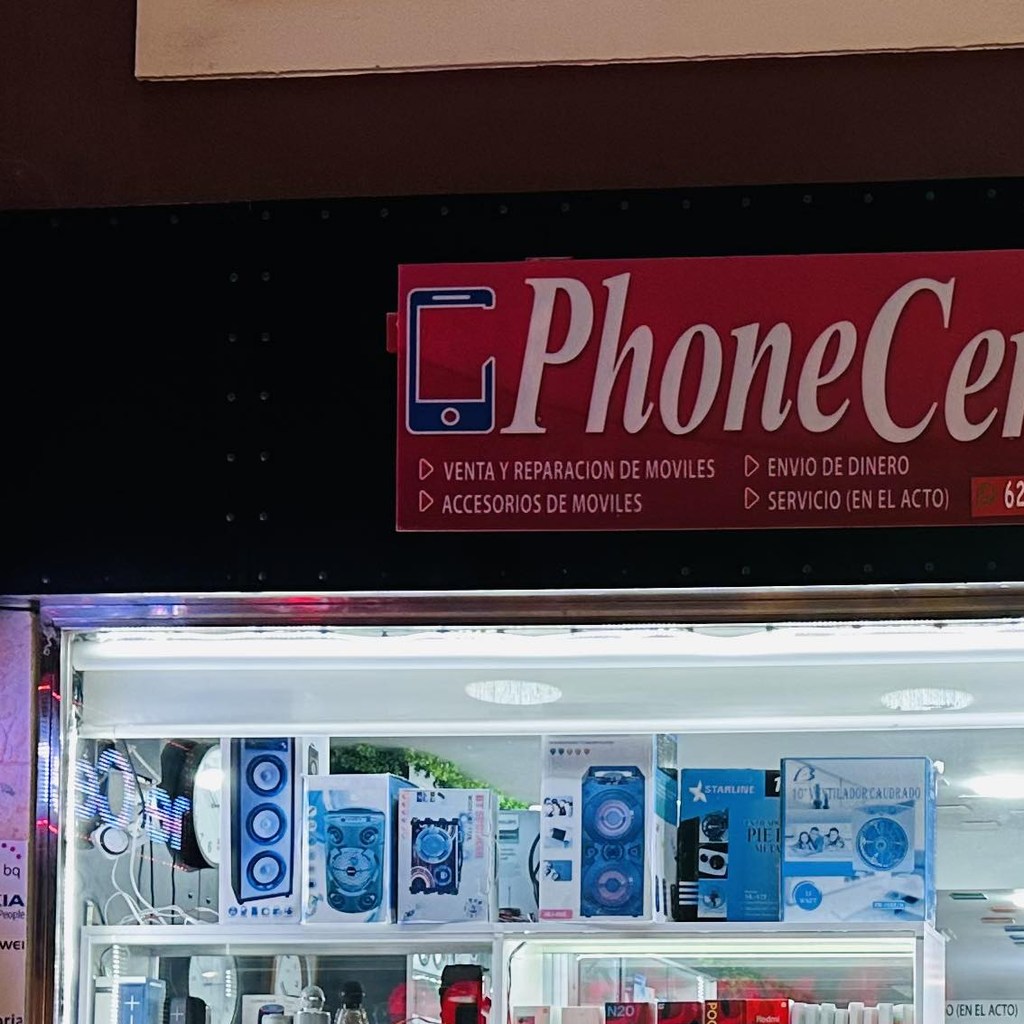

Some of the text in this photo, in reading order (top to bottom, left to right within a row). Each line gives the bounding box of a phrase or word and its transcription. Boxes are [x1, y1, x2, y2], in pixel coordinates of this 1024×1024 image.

[443, 457, 716, 482] VENTA Y REPARACION DE MOVILES
[767, 455, 910, 477] ENVIO DE DINERO
[441, 492, 643, 516] ACCESORIOS DE MOVILES
[767, 487, 950, 512] SERVICIO (EN EL ACTO)
[704, 783, 756, 795] STARLINE
[3, 863, 21, 880] bq
[0, 894, 25, 907] IA
[606, 1004, 636, 1018] N20
